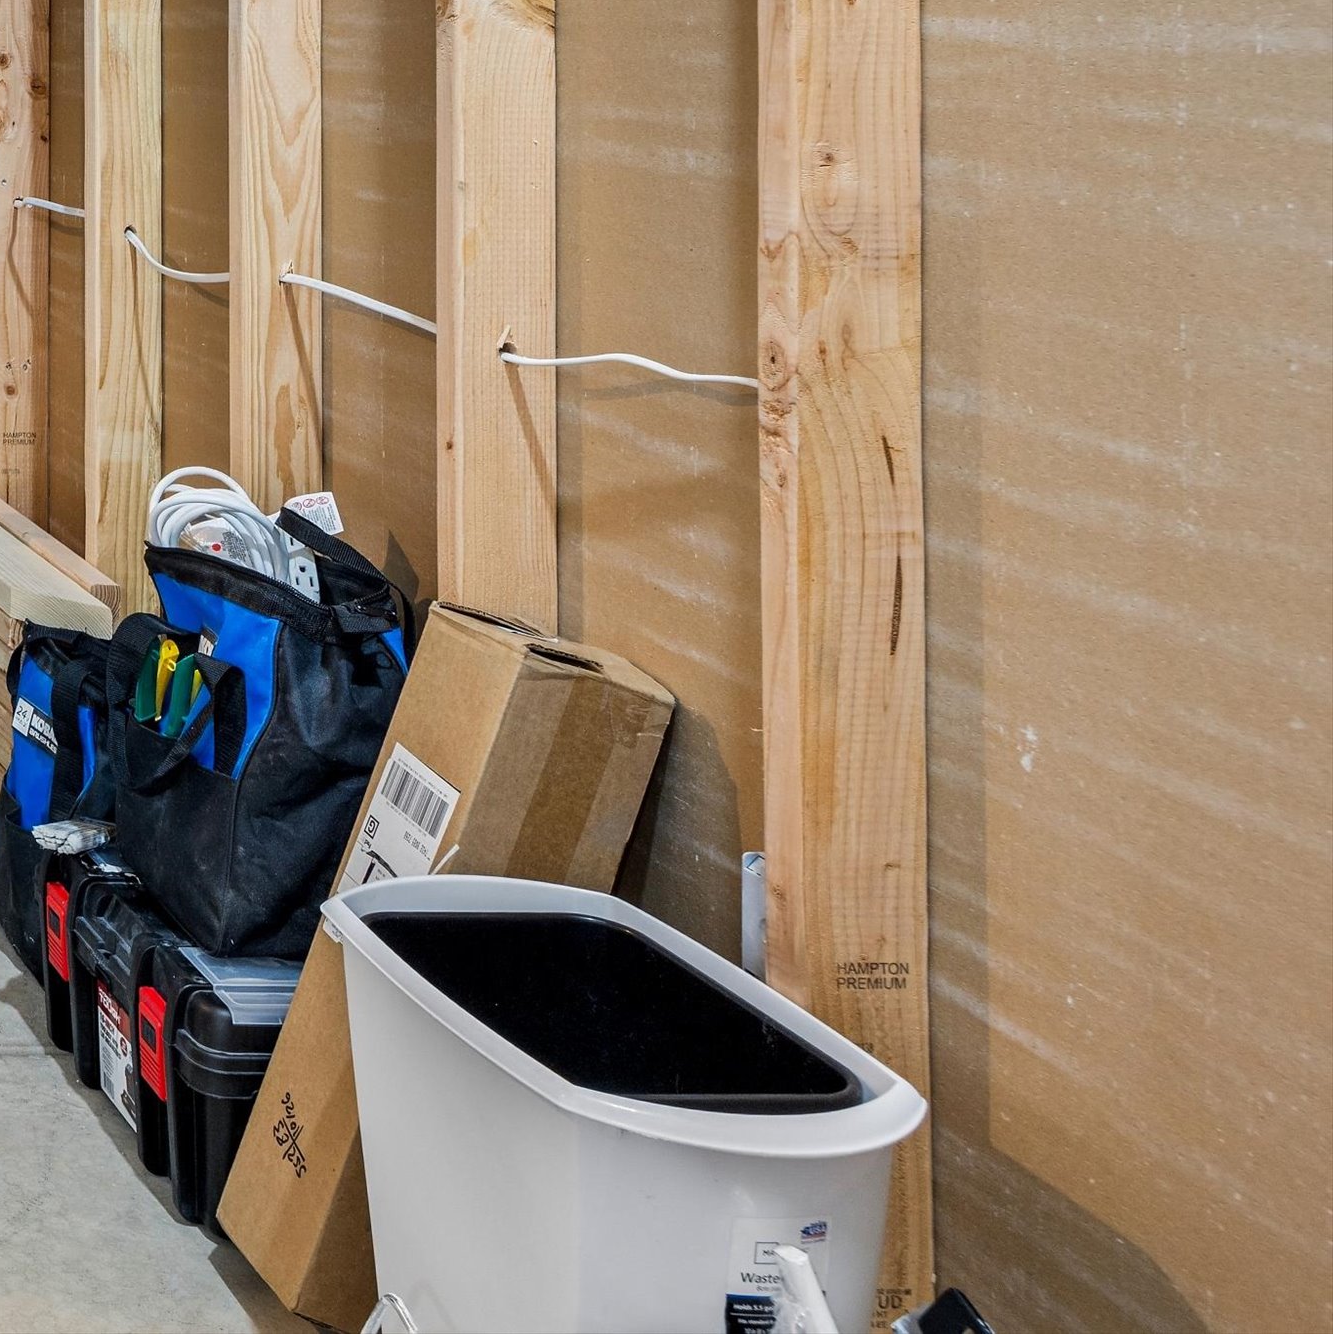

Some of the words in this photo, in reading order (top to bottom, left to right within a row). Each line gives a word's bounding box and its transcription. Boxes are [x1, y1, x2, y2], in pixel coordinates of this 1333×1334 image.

[836, 962, 910, 975] HAMPTON
[836, 977, 907, 990] PREMIUM
[740, 1272, 784, 1284] Waste
